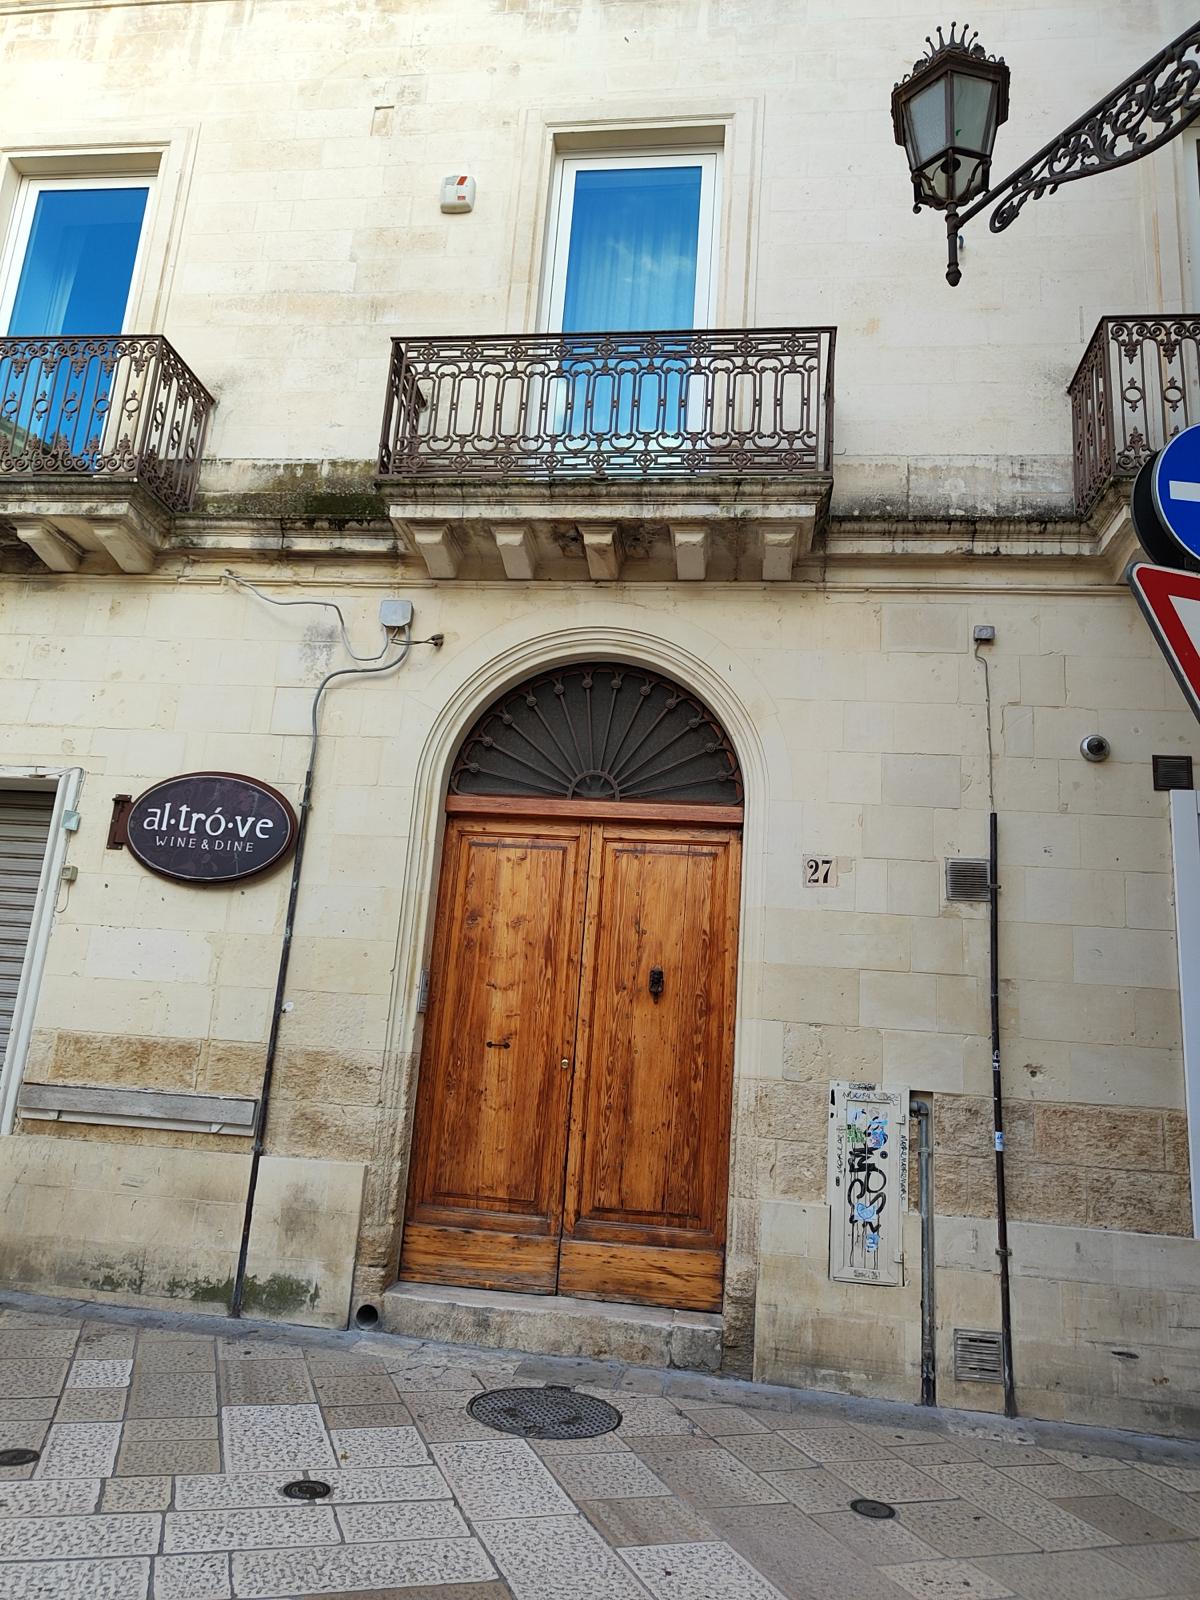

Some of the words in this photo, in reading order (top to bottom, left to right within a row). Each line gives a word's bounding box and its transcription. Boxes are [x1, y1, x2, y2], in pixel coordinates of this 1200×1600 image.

[155, 836, 197, 849] WINE
[201, 840, 210, 850] &
[214, 840, 254, 853] DINE
[807, 859, 833, 884] 27
